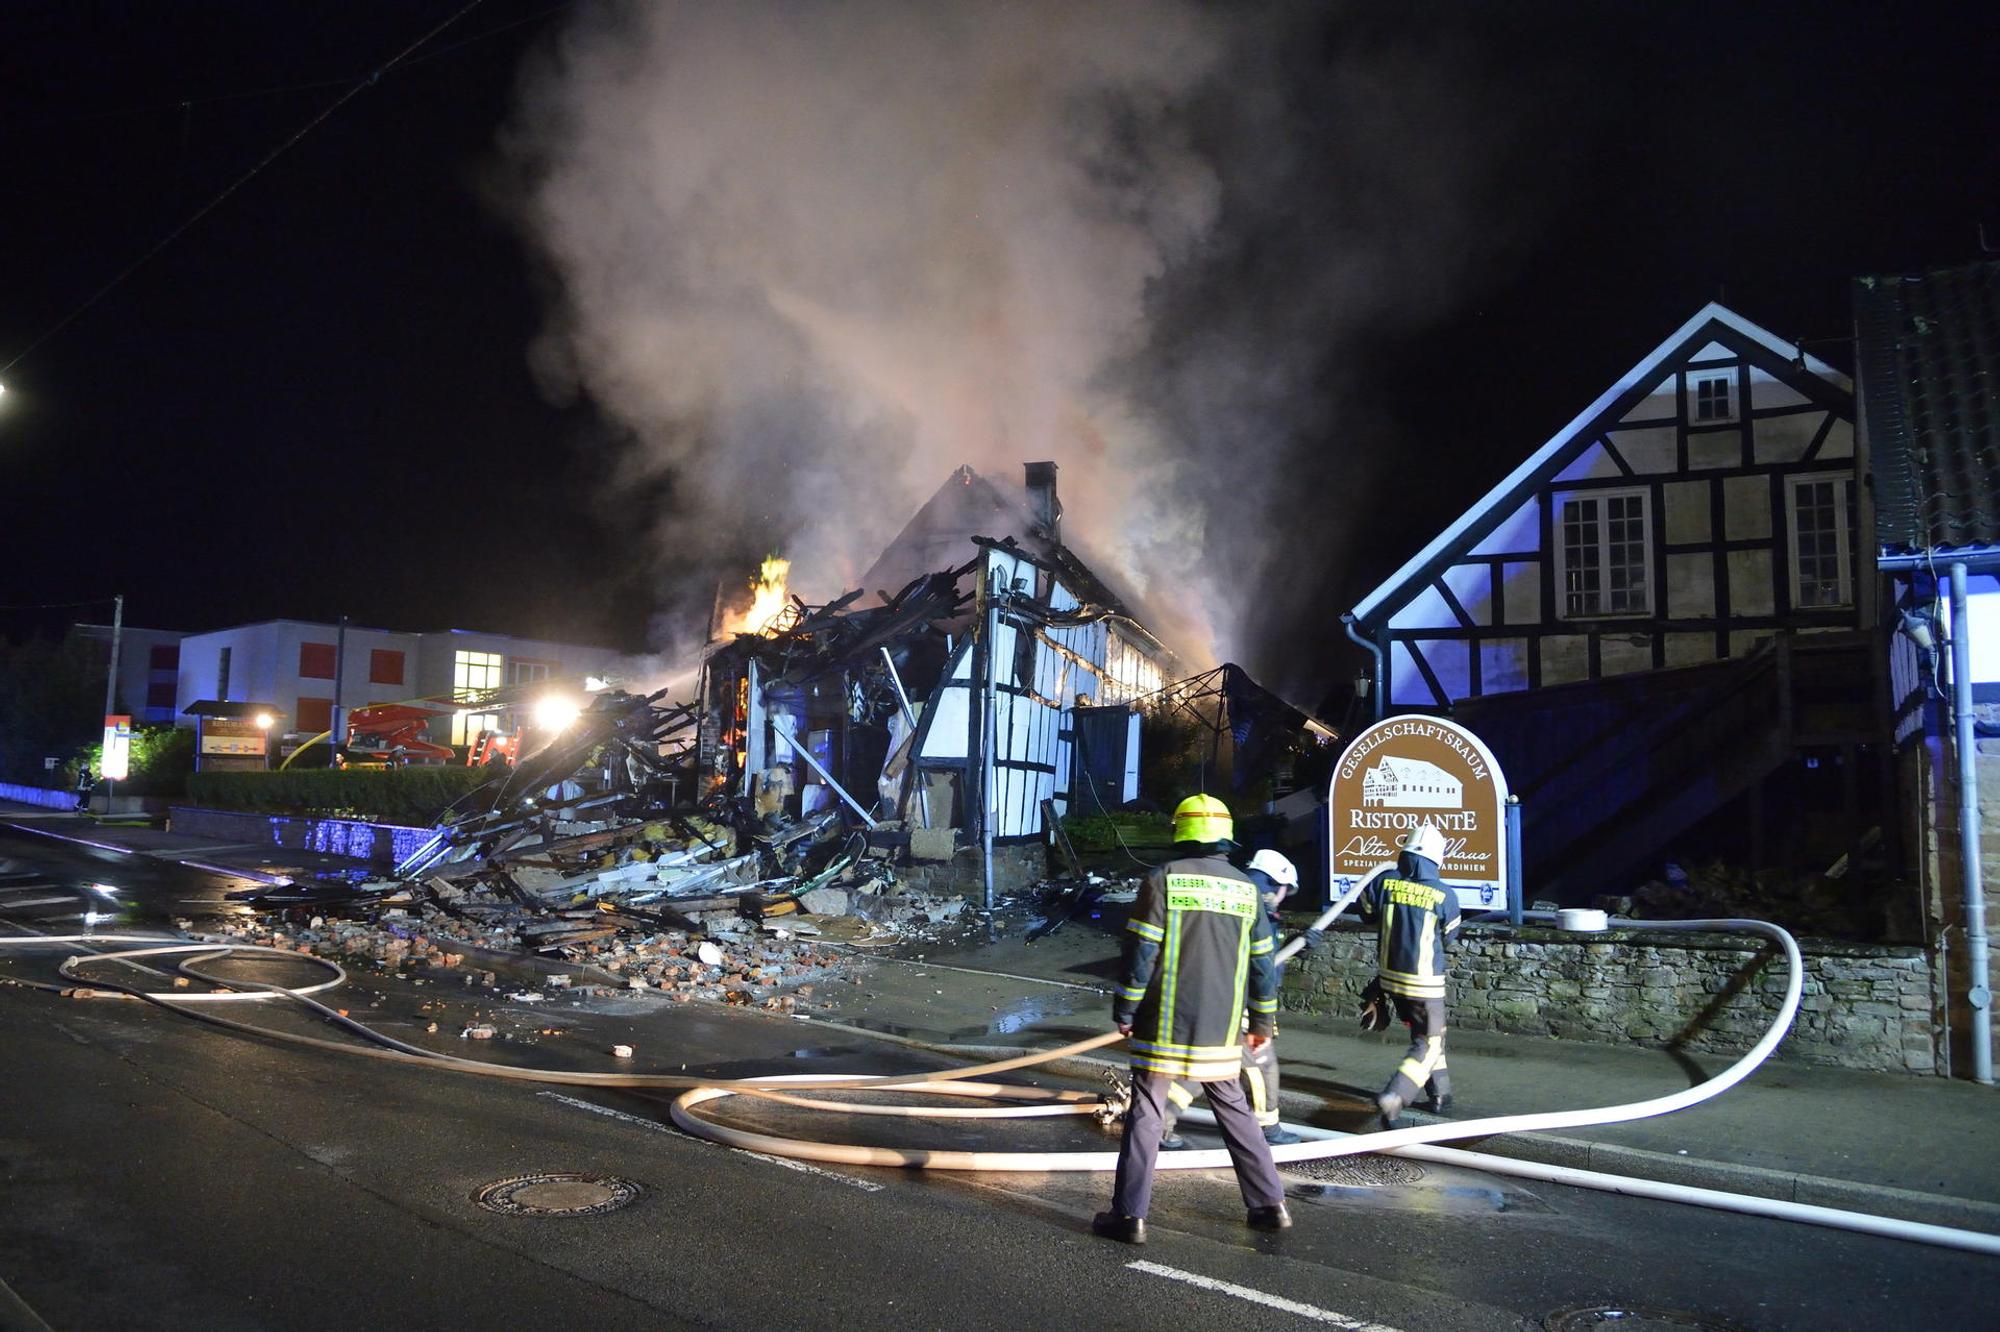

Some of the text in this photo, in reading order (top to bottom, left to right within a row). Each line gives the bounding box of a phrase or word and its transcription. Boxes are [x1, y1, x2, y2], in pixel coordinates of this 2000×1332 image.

[1341, 722, 1488, 781] GESELLSCHAFTSRAUM
[1350, 809, 1477, 831] RISTORANTE
[1336, 835, 1395, 857] Altes
[1438, 863, 1486, 872] ARDINIEN
[1383, 878, 1446, 905] FEUERWEHR
